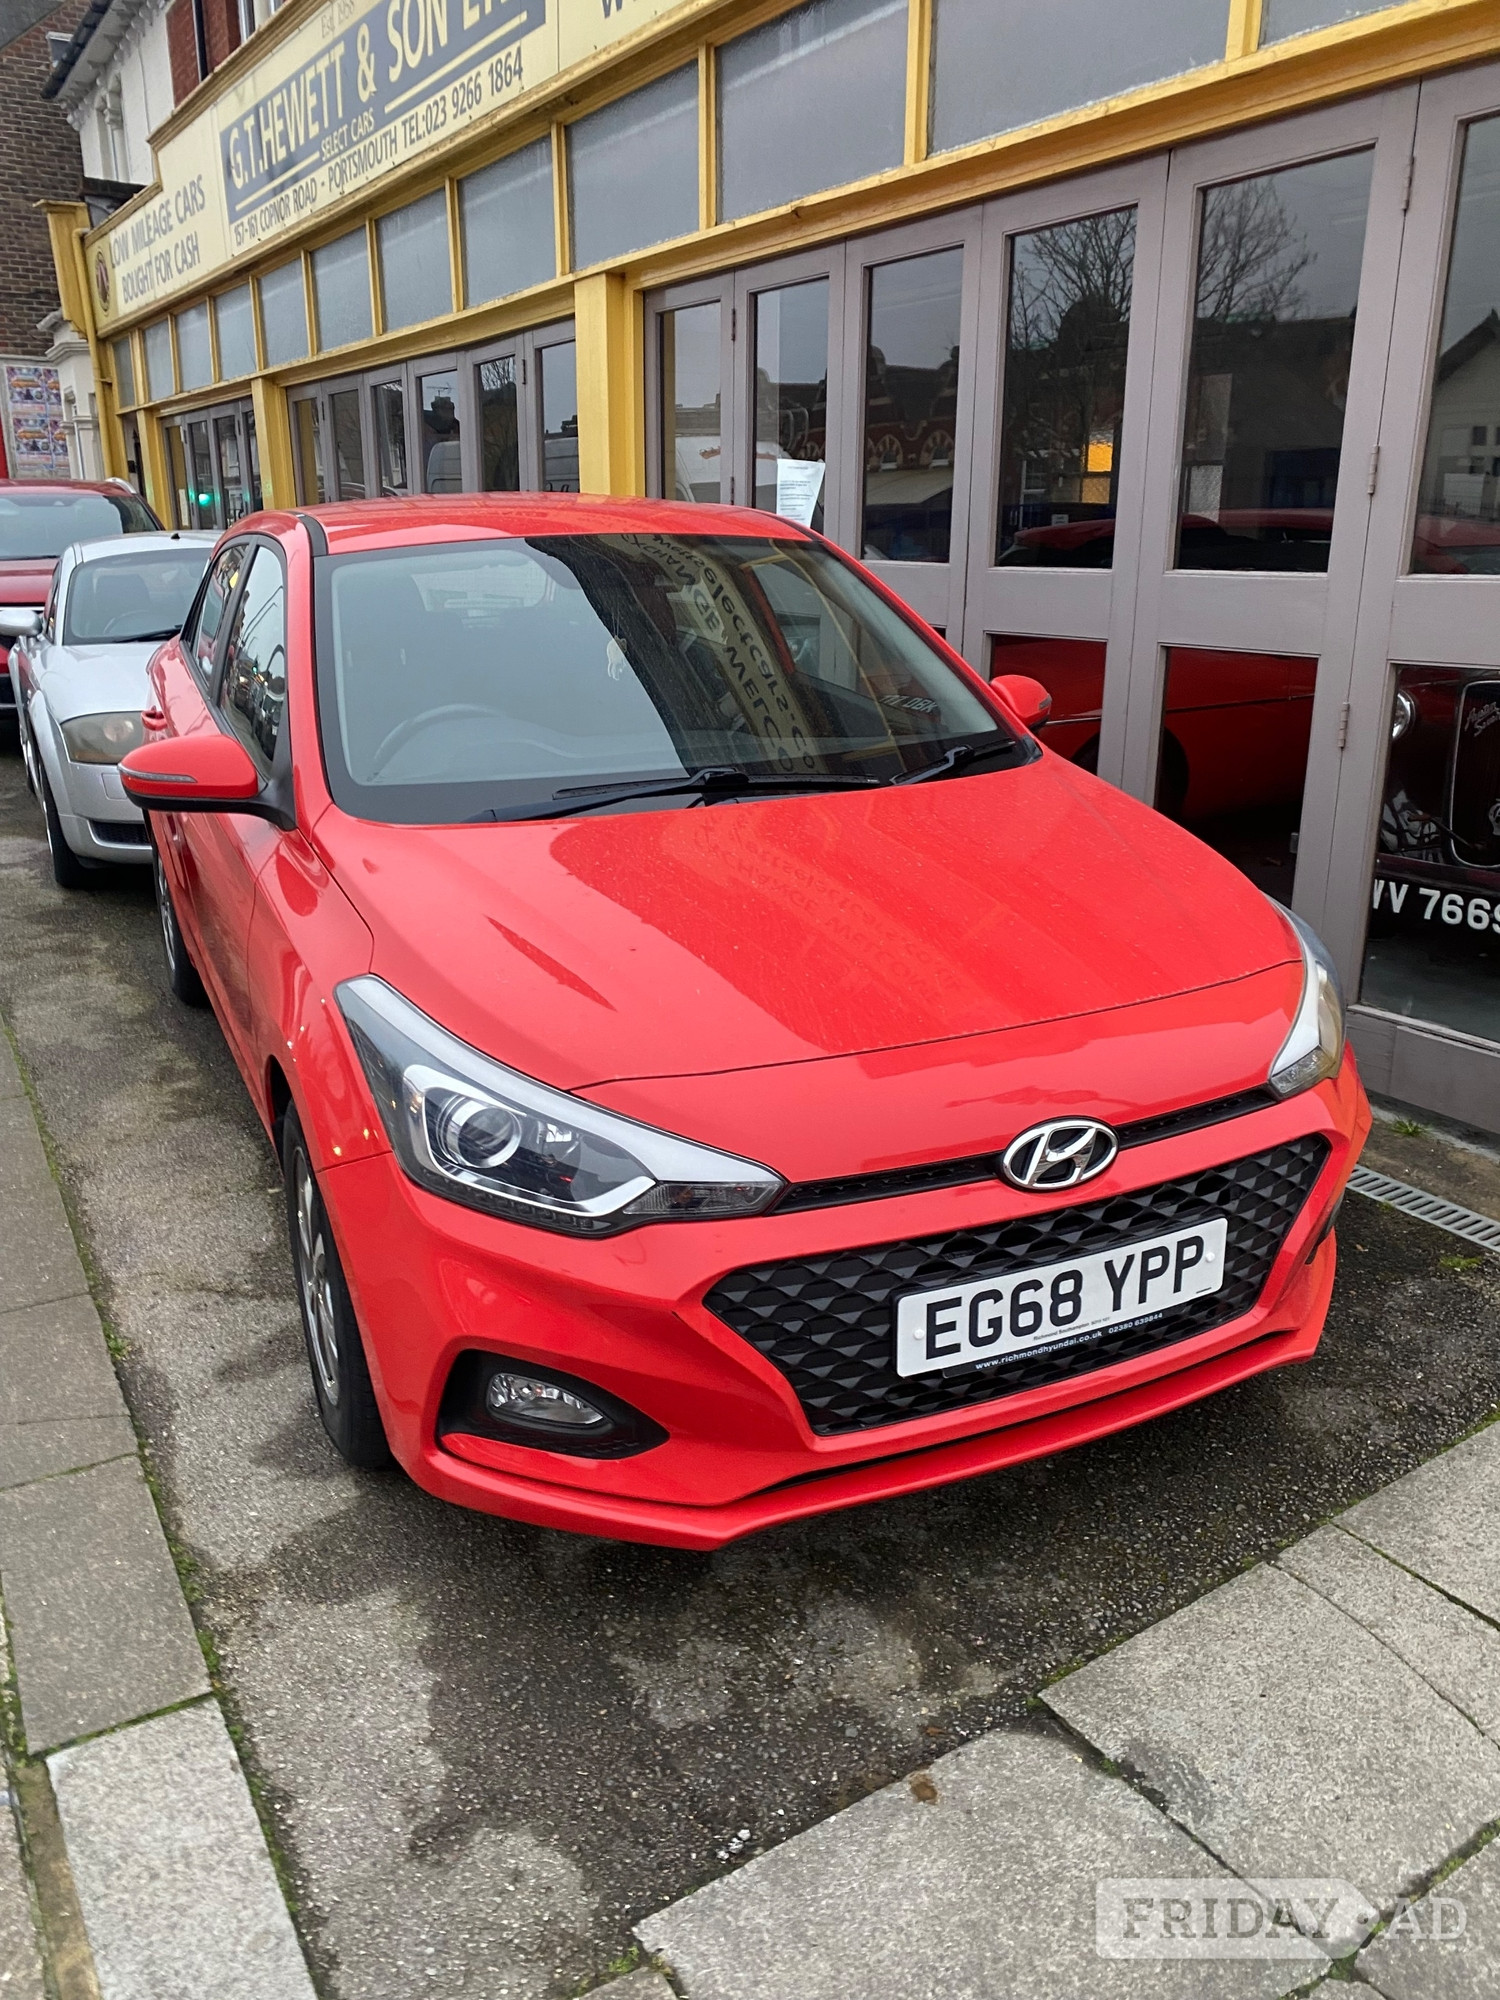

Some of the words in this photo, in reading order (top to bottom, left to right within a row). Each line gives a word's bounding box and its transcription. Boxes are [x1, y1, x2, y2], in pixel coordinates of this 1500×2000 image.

[357, 23, 377, 103] &
[386, 0, 448, 83] SON
[234, 215, 259, 246] 157-161
[260, 194, 291, 232] COPNOR
[293, 177, 318, 213] ROAD
[328, 125, 397, 192] PORTSMOUTH
[452, 71, 482, 120] 9266
[488, 45, 523, 97] 1864
[321, 124, 348, 161] SELECT
[351, 107, 375, 142] CARS
[109, 230, 129, 269] LOW
[131, 198, 174, 256] MILEAGE
[175, 174, 206, 224] CARS
[122, 260, 154, 304] BOUGHT
[154, 249, 174, 285] FOR
[174, 230, 201, 276] CASH
[926, 1269, 1083, 1361] EG68
[1104, 1235, 1205, 1313] YPP
[975, 1330, 1103, 1371] www.richmondhyundai.co.uk
